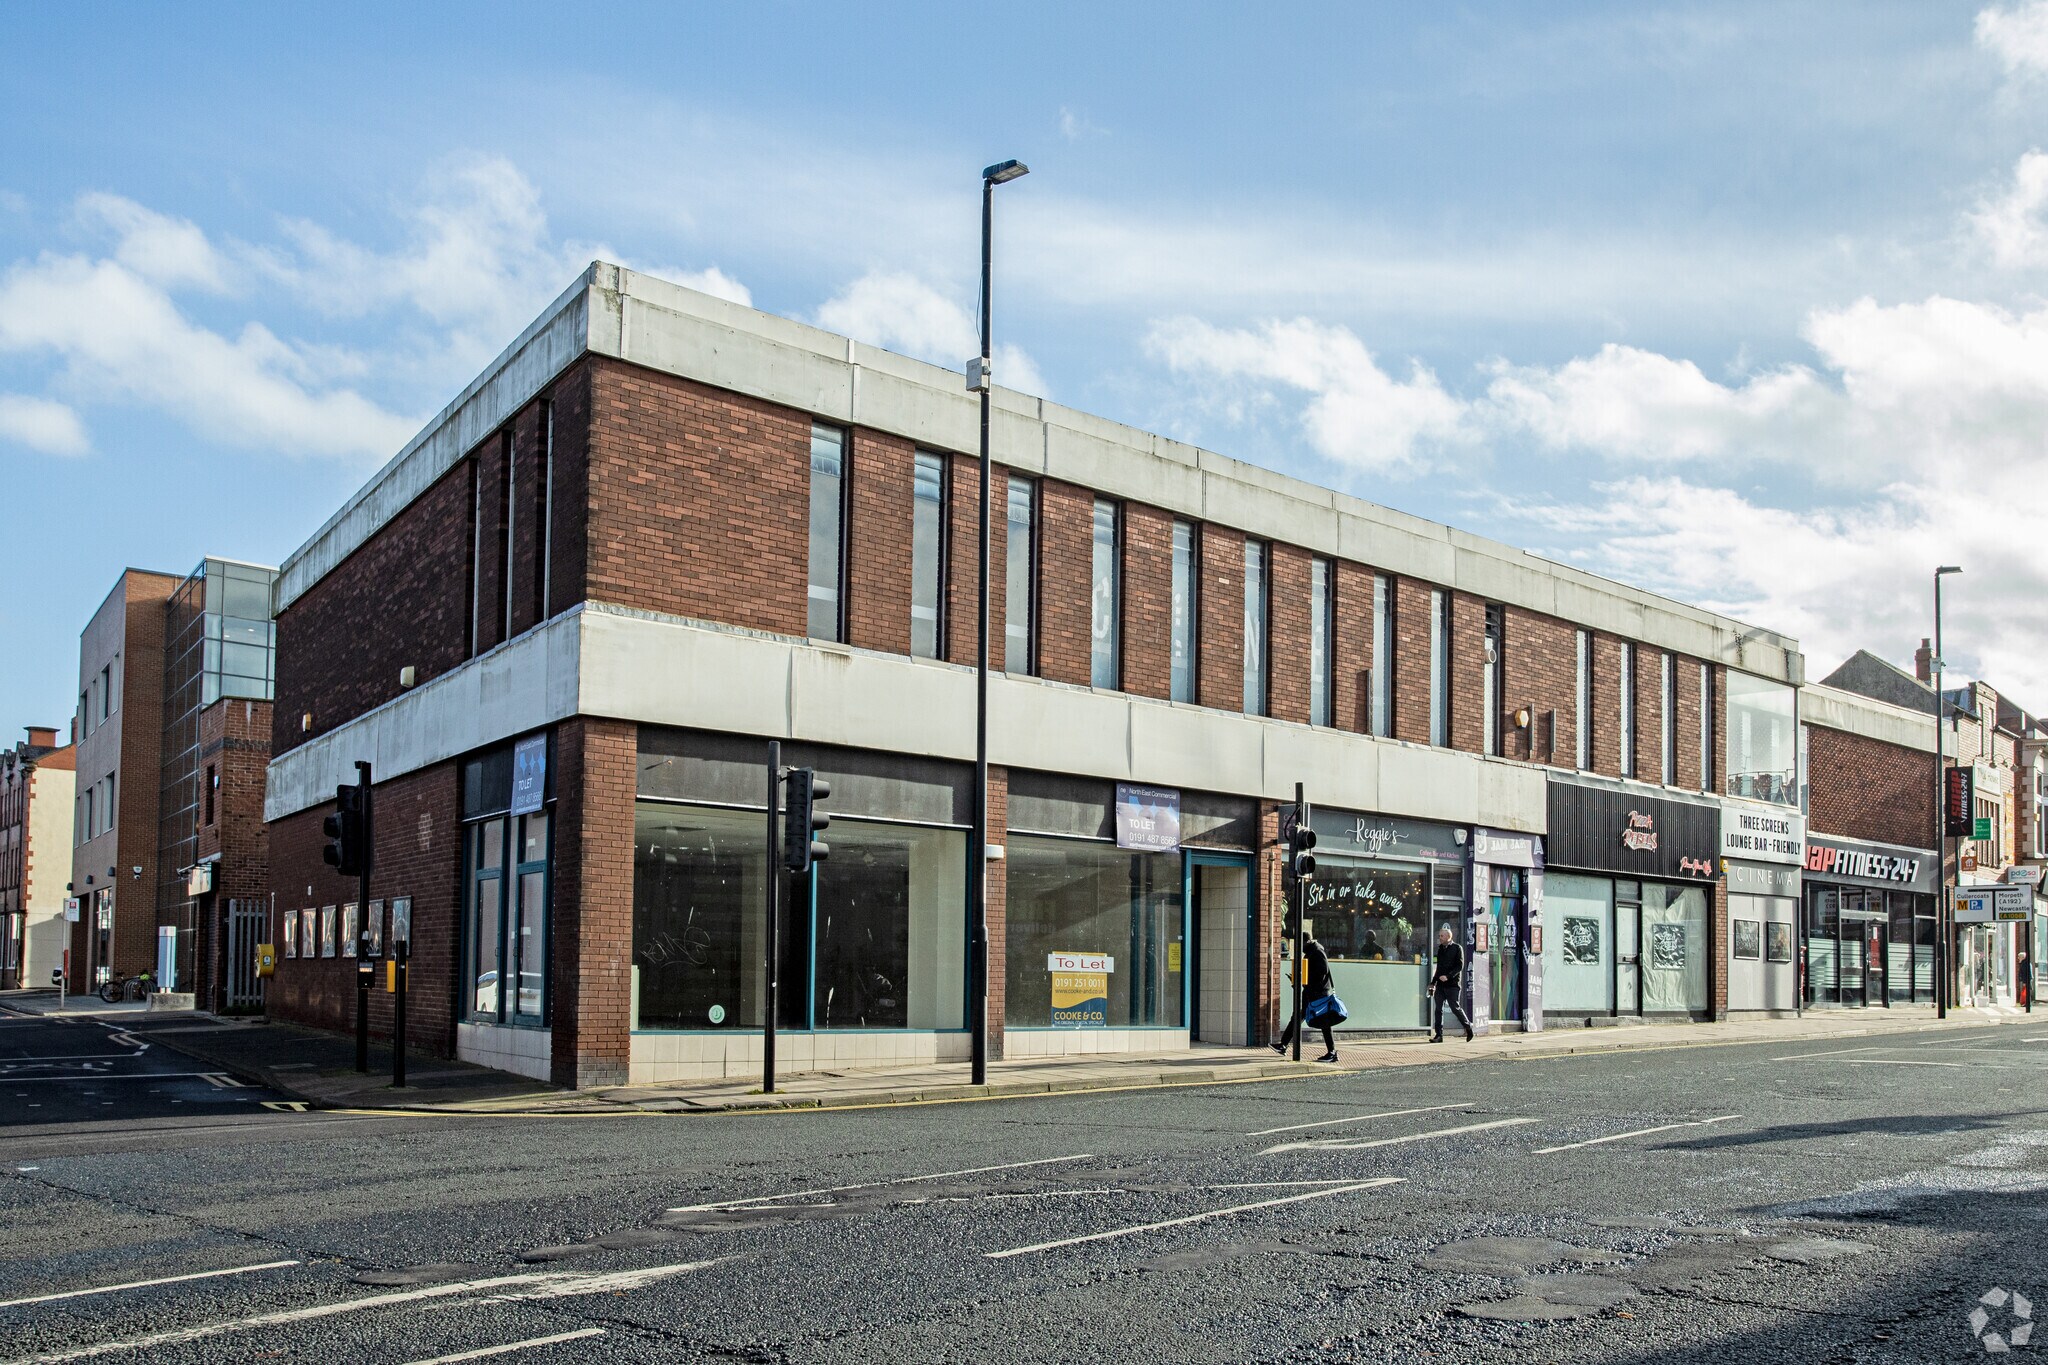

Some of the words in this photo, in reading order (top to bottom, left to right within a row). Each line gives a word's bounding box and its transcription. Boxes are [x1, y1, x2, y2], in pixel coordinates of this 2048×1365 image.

[1151, 791, 1177, 799] Commercial
[1129, 818, 1140, 829] TO
[1141, 820, 1156, 830] LET
[1740, 815, 1760, 831] THREE
[1760, 818, 1789, 835] SCREENS
[1129, 832, 1146, 842] 0191
[1147, 833, 1160, 844] 487
[1160, 835, 1177, 846] 8566
[1345, 818, 1409, 851] Reggie's
[1726, 833, 1752, 850] LOUNGE
[1736, 867, 1793, 886] CINEMA
[1308, 882, 1324, 906] Sit
[1326, 883, 1336, 900] in
[1339, 885, 1351, 898] or
[1355, 880, 1377, 900] take
[1379, 892, 1403, 916] away
[1055, 957, 1075, 968] To
[1080, 958, 1106, 970] Let
[1055, 977, 1072, 988] 0191
[1074, 978, 1087, 988] 251
[1088, 978, 1105, 988] 0011
[1054, 1011, 1082, 1021] COOKE
[1082, 1011, 1090, 1020] &
[1090, 1011, 1105, 1021] CO.
